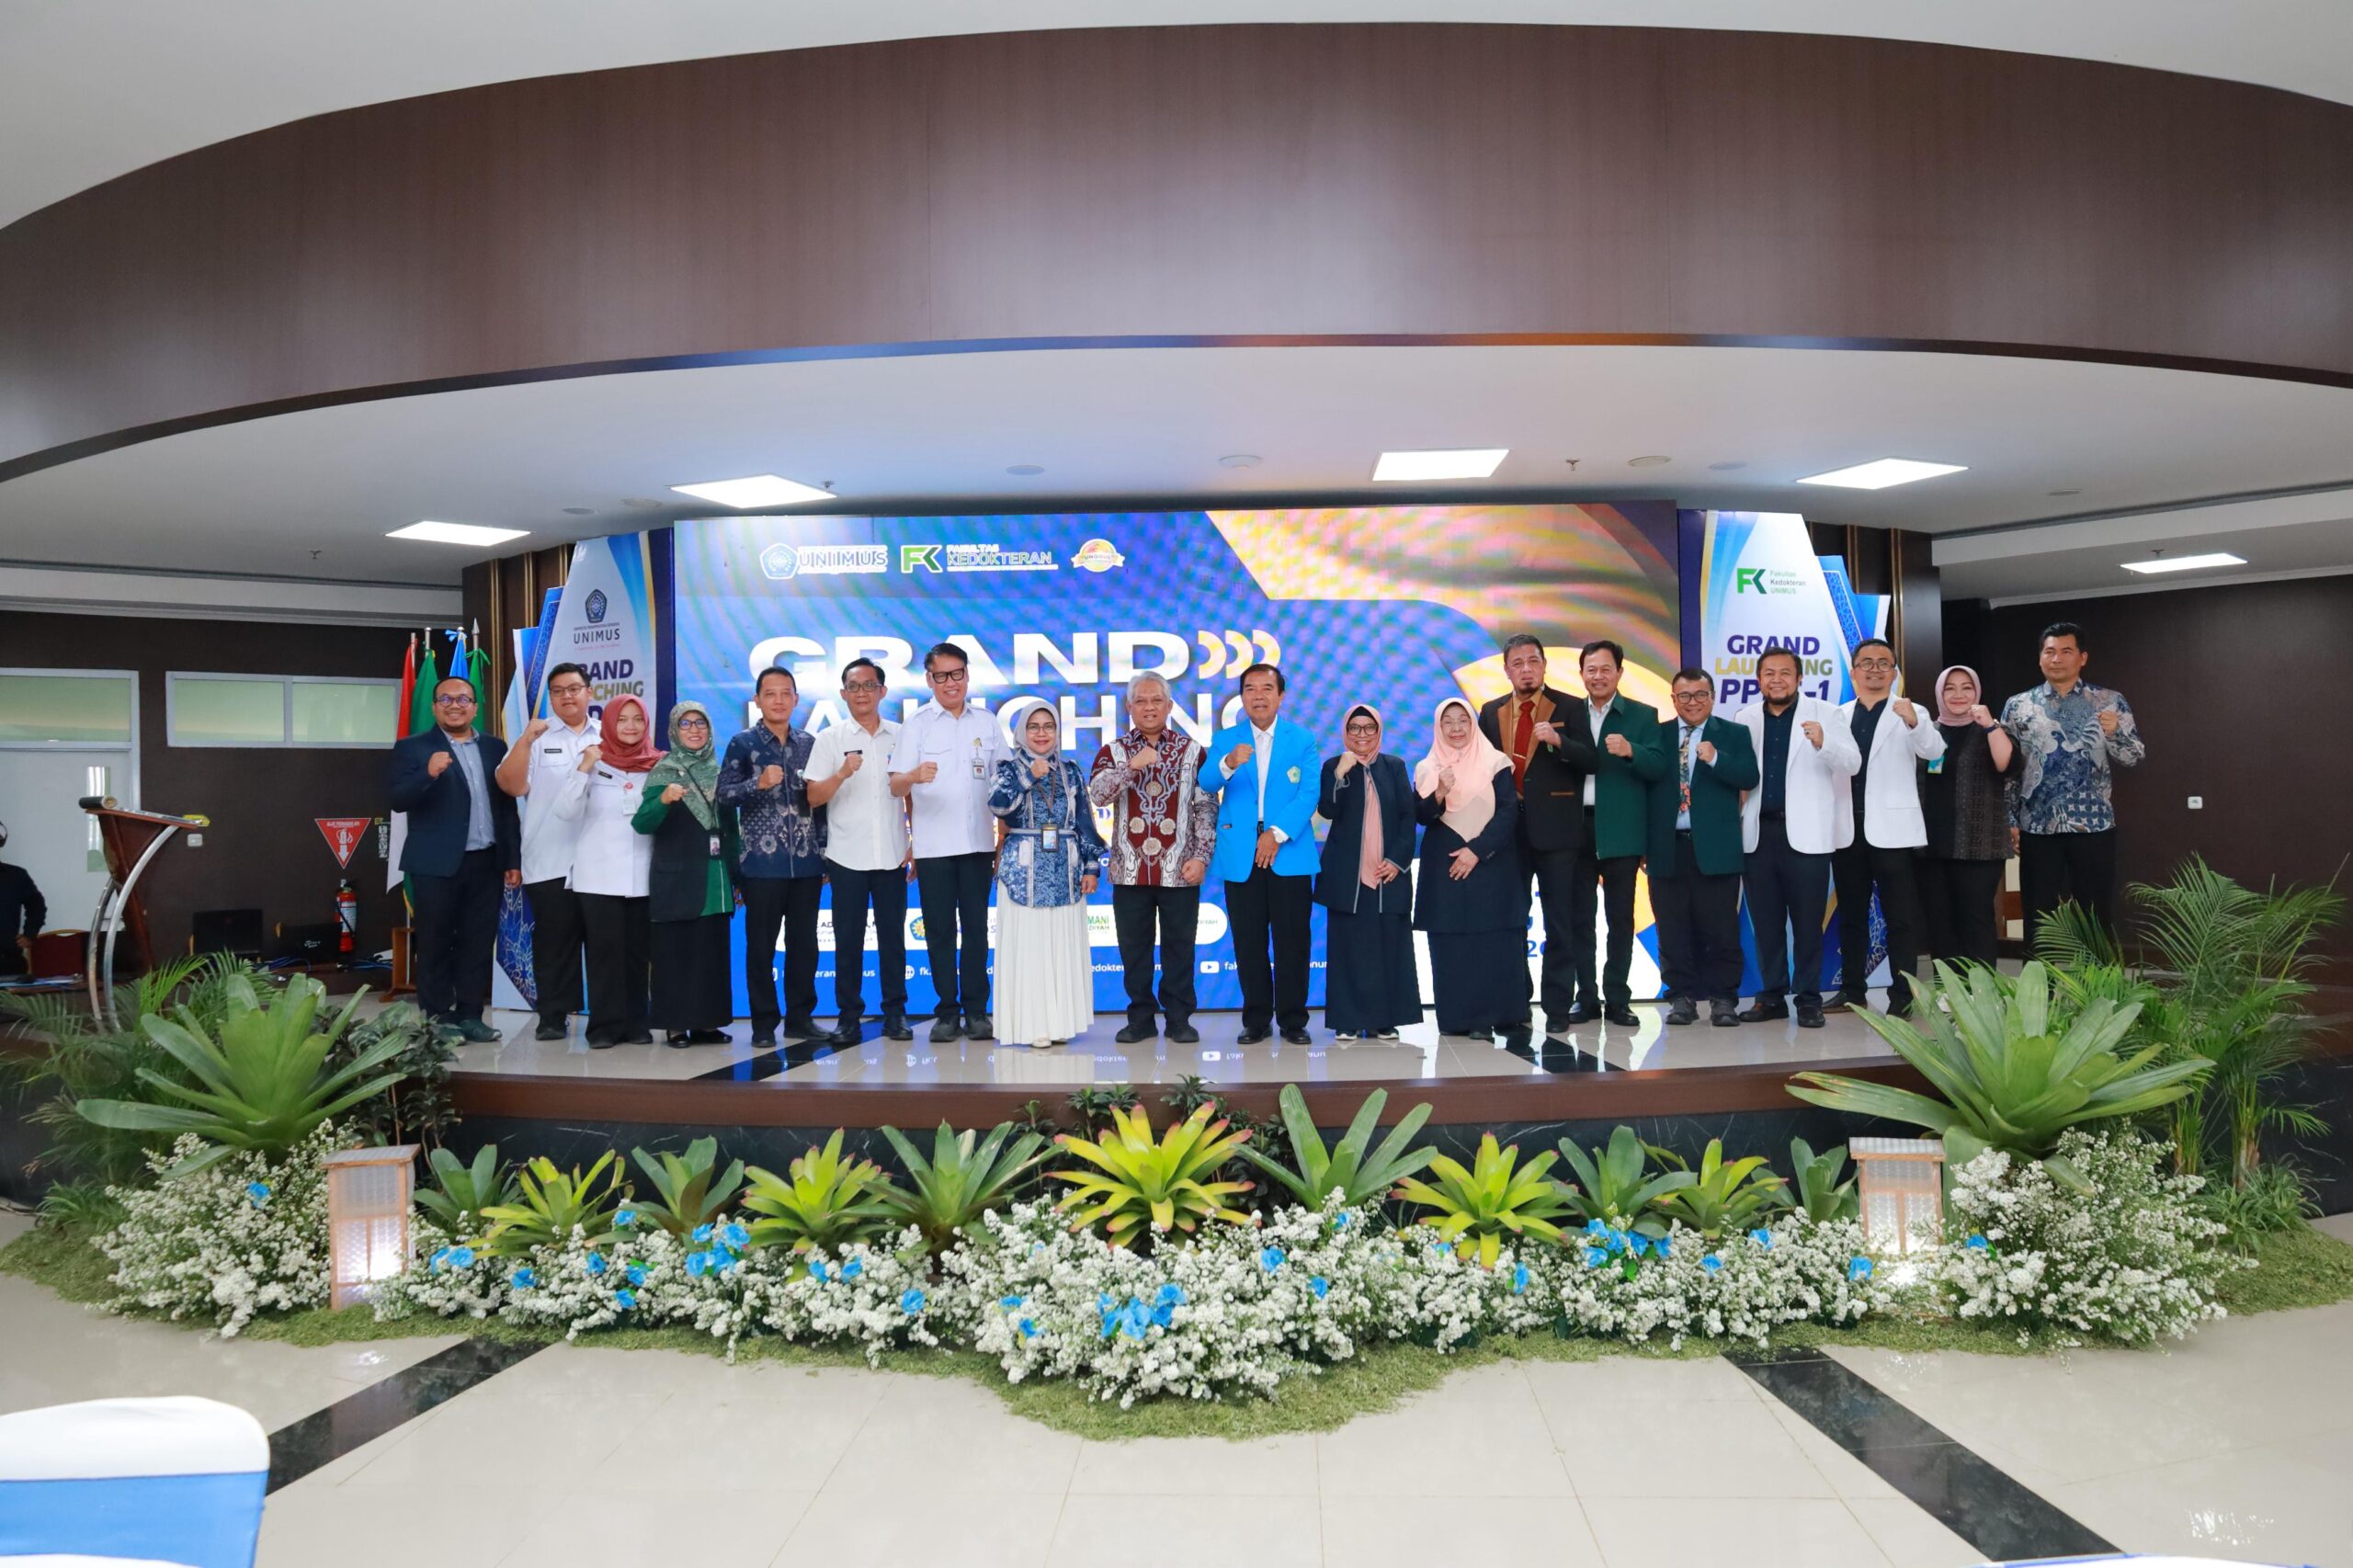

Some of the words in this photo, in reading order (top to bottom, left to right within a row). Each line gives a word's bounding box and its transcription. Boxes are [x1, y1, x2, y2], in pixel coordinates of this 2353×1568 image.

[798, 551, 887, 566] UNIMUS
[947, 551, 1052, 566] KEDOKTERAN
[1736, 568, 1767, 594] FK
[574, 628, 620, 644] UNIMUS
